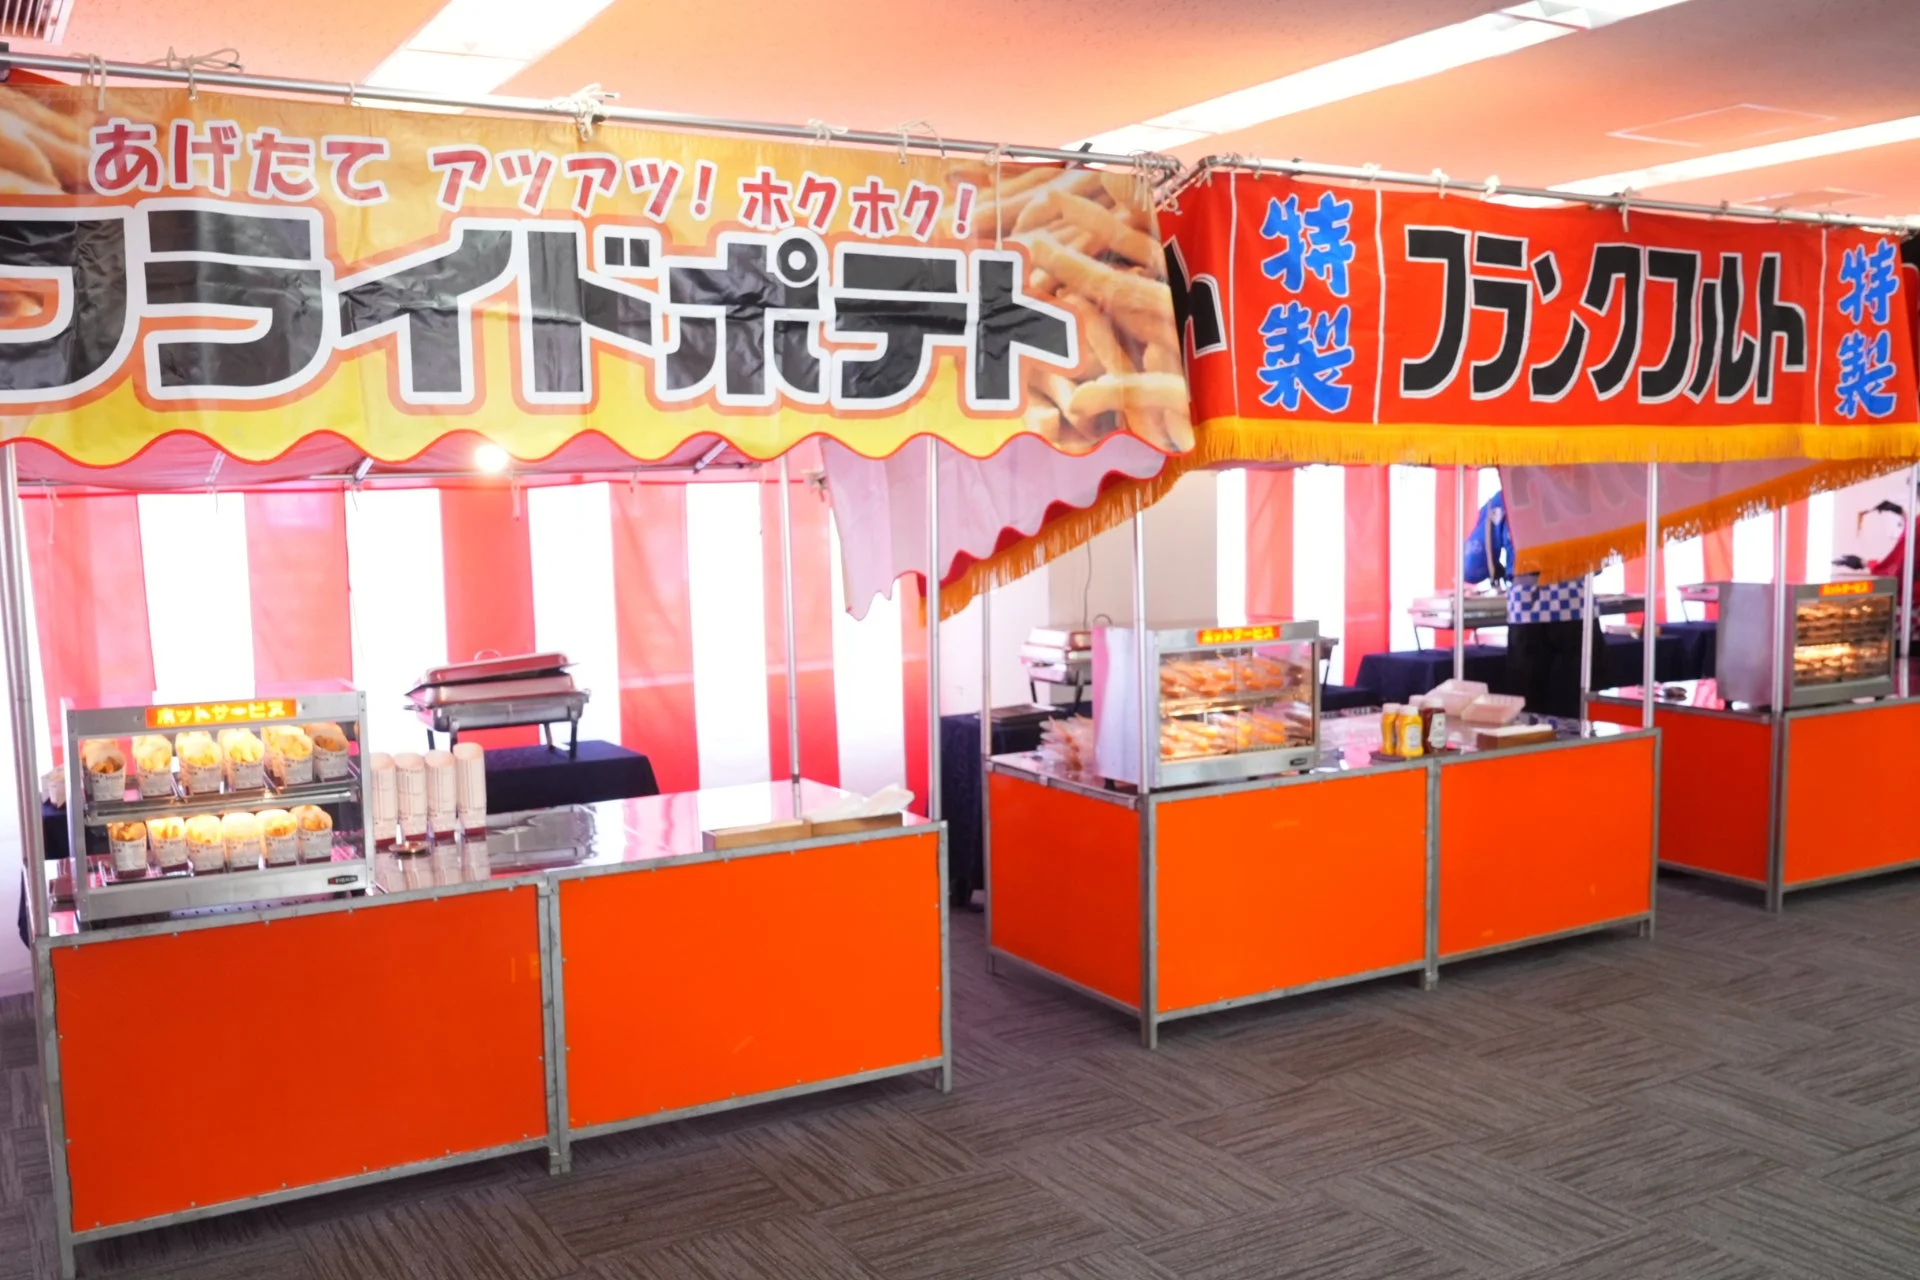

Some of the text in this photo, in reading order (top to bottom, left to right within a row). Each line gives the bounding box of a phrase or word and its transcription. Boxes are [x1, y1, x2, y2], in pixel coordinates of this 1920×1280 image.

[94, 121, 977, 240] あげたて アツアツ! ホクホク!
[0, 205, 1074, 405] フライドポテト
[1258, 190, 1354, 414] 特製
[1400, 225, 1808, 404] フランクフルト
[1834, 237, 1899, 419] 特製
[156, 701, 286, 725] ホットサービス
